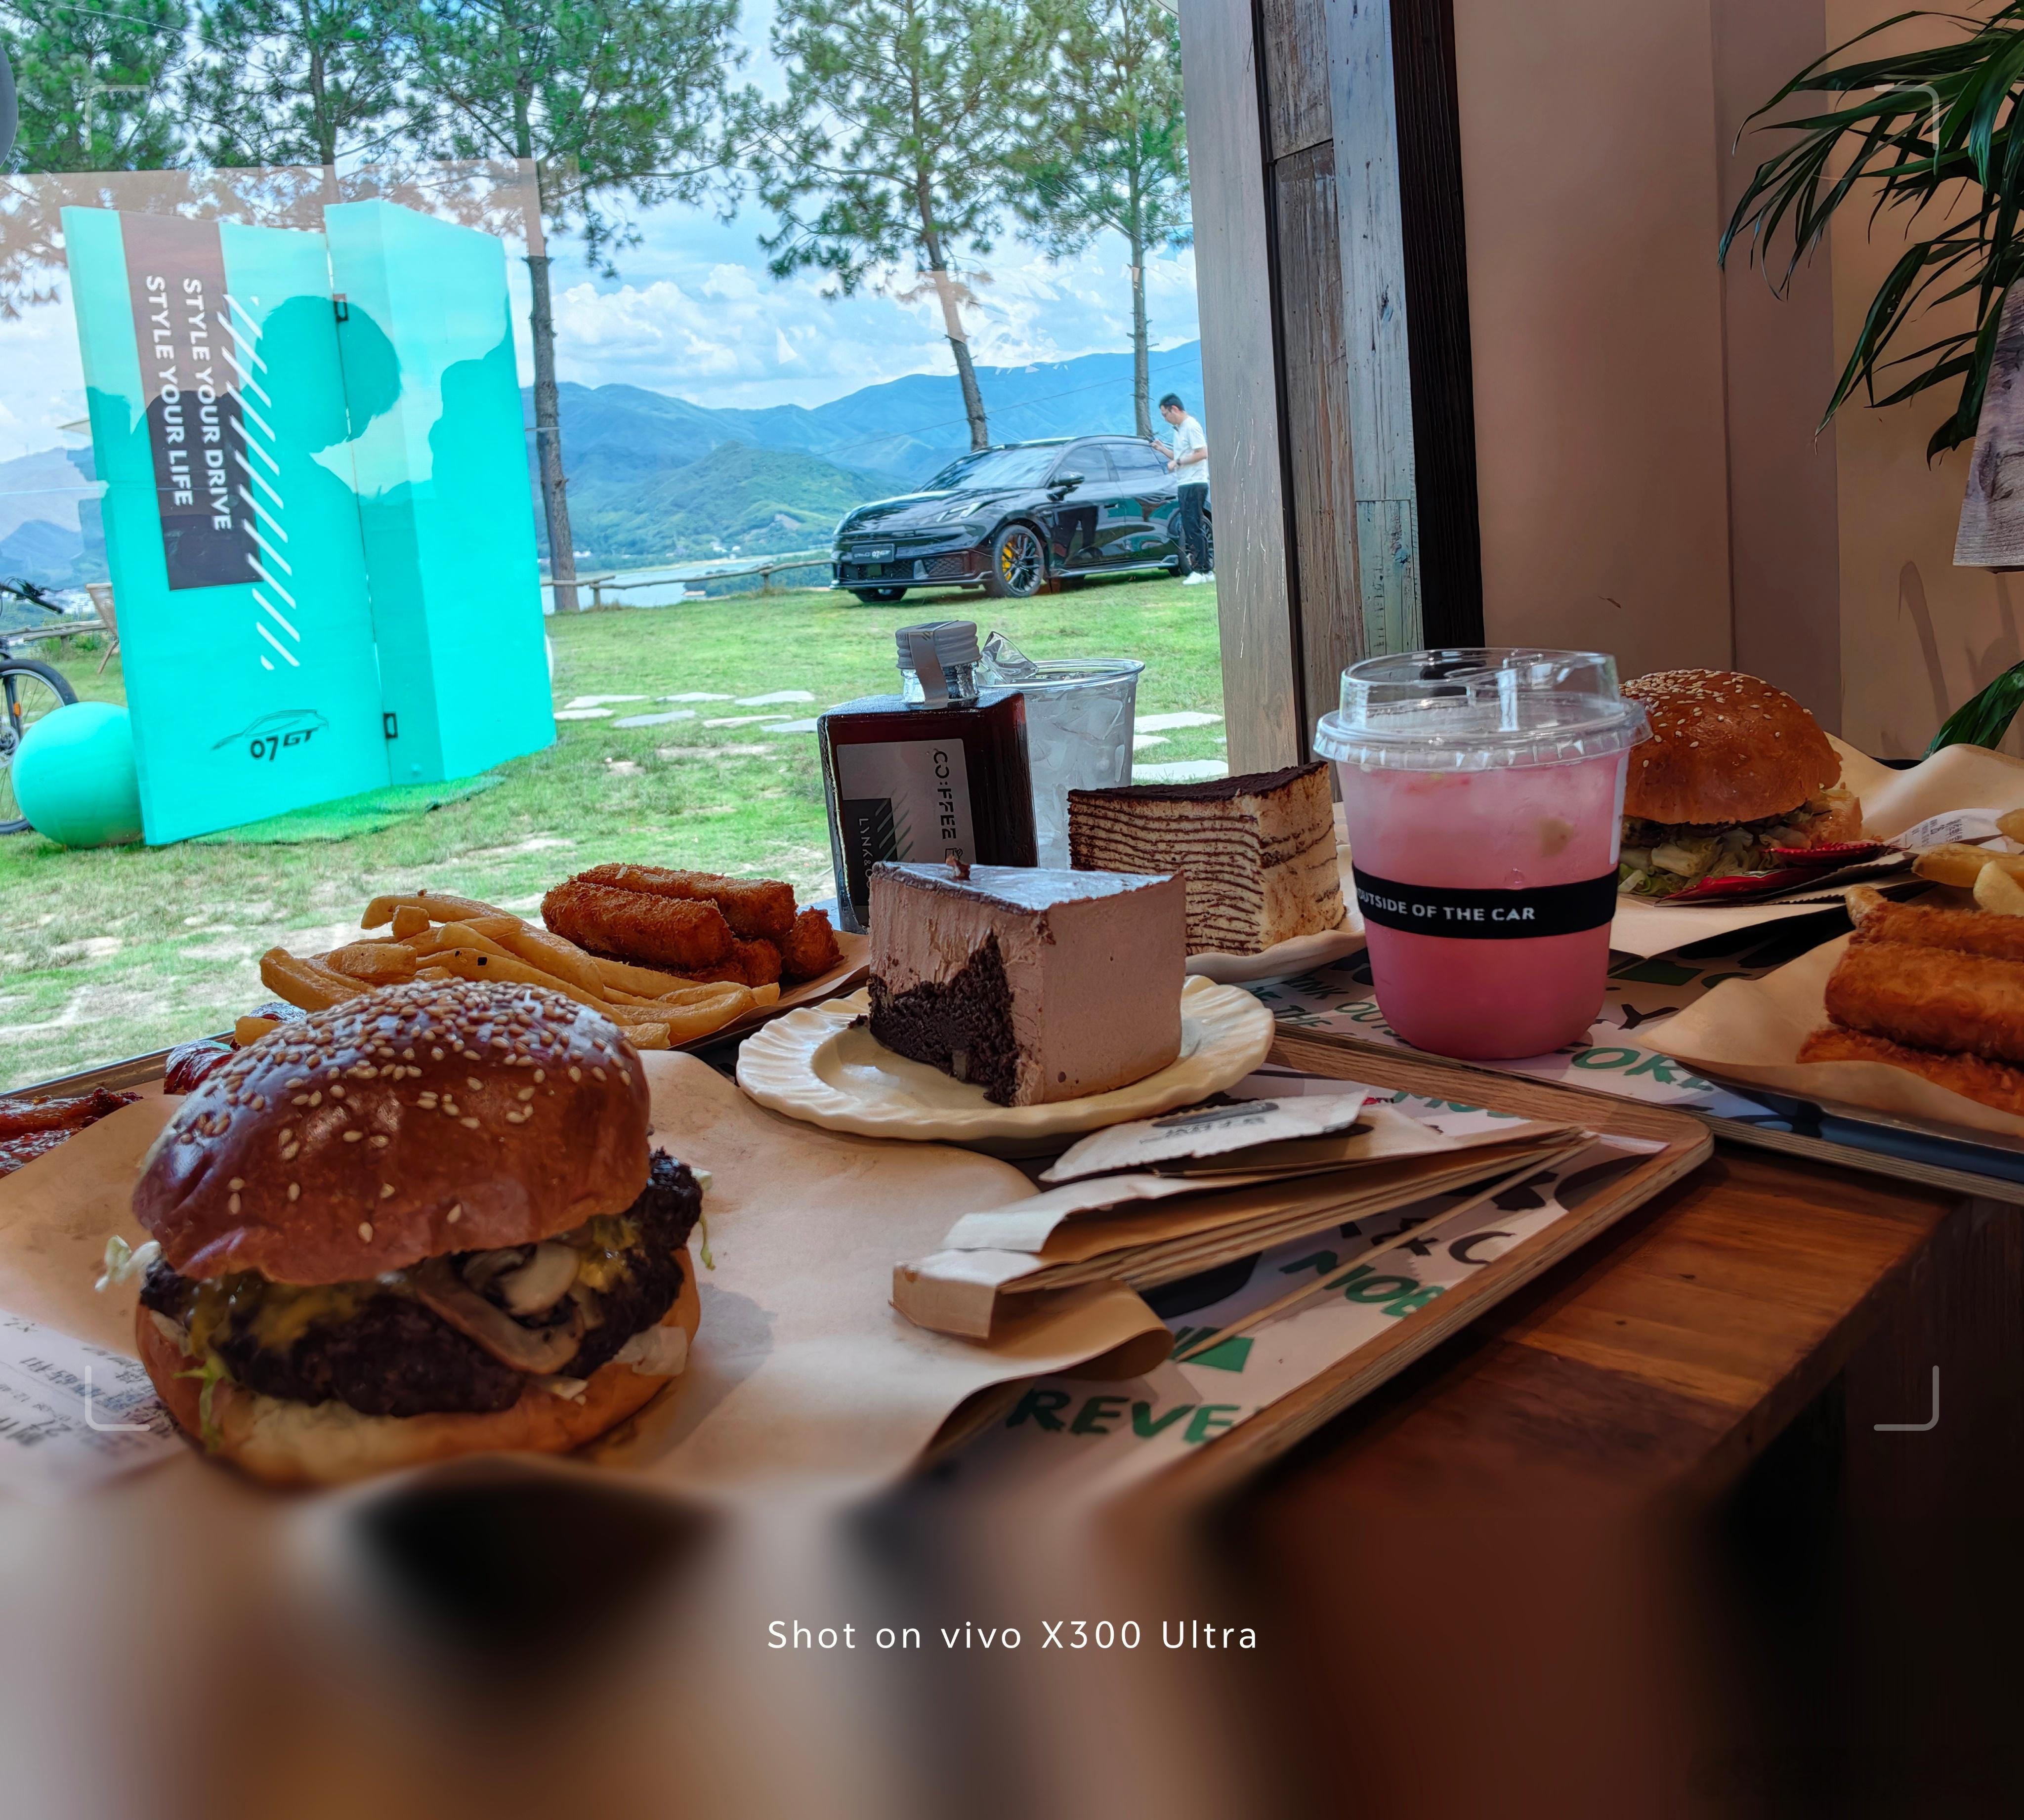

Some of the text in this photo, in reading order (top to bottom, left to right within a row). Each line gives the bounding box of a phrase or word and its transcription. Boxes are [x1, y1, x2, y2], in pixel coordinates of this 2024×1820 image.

[146, 275, 193, 506] STYLE YOUR LIFE
[183, 278, 232, 532] STYLE YOUR DRIVE
[1412, 904, 1437, 918] OF
[1442, 907, 1485, 921] THE
[1491, 907, 1536, 921] CAR
